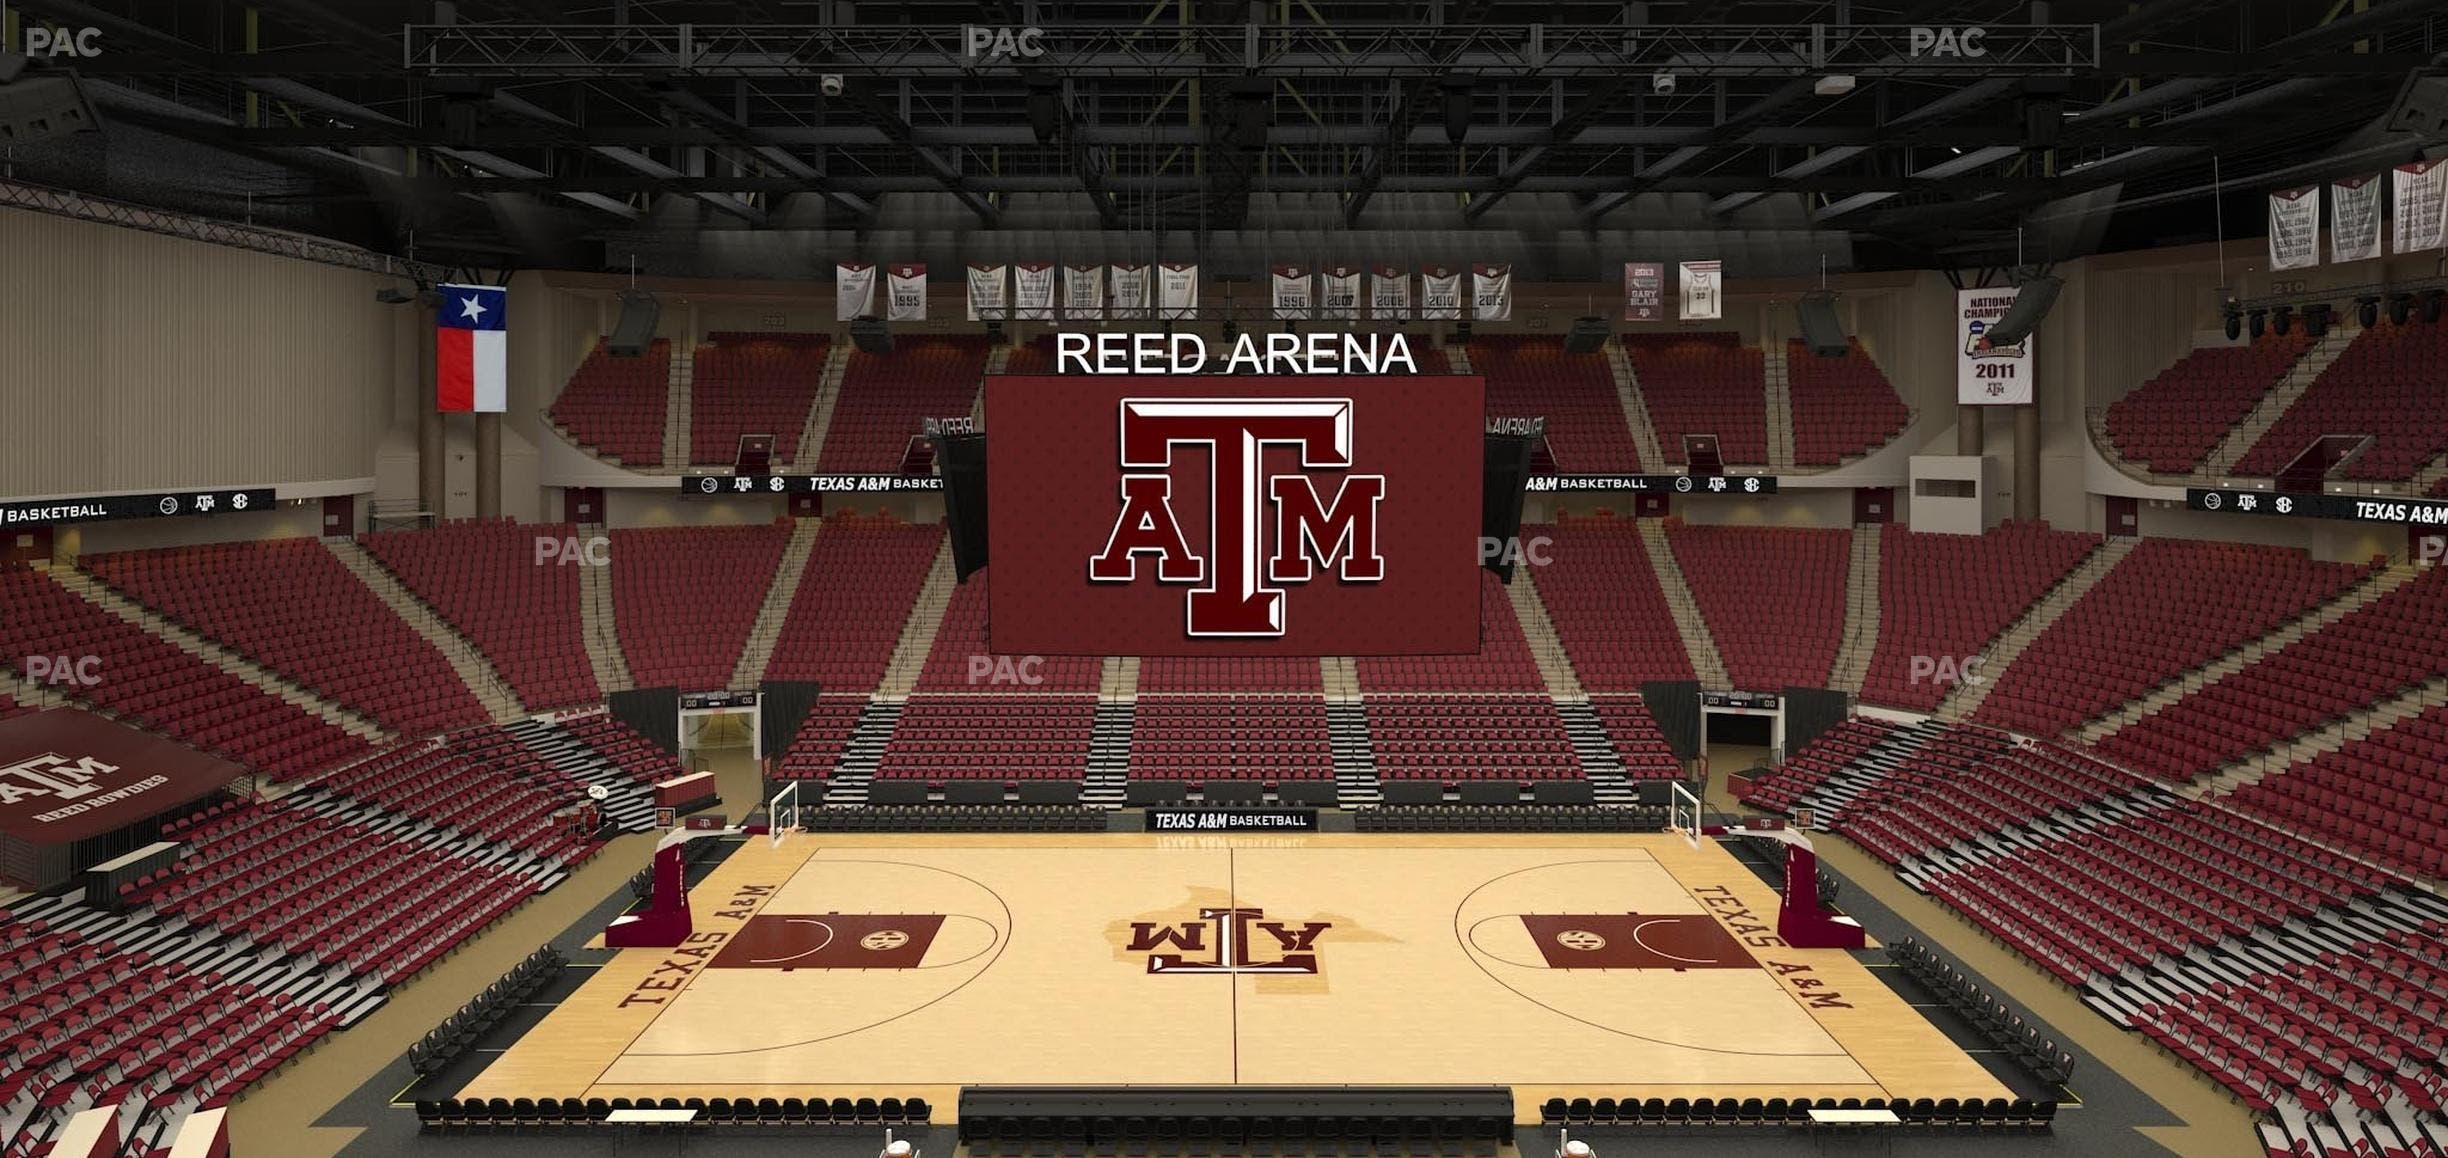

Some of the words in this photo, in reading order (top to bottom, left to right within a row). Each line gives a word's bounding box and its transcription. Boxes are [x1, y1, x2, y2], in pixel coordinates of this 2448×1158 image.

[894, 295, 921, 307] 1995
[1429, 295, 1454, 306] 2010
[1479, 295, 1503, 306] 2013
[1630, 298, 1658, 306] BLAIR
[1631, 290, 1657, 298] GARY
[1057, 332, 1206, 374] REED
[1225, 332, 1418, 374] ARENA
[1975, 363, 2015, 379] 2011
[810, 477, 855, 491] TEXAS
[857, 477, 891, 491] A&M
[1525, 477, 1558, 491] A&M
[1560, 478, 1647, 489] BASKETBALL
[7, 503, 107, 523] BASKETBALL
[2356, 501, 2406, 522] TEXAS
[2409, 503, 2448, 525] A&M
[32, 802, 91, 823] REED
[84, 774, 169, 808] ROWDIES
[1156, 813, 1196, 829] TEXAS
[1198, 813, 1228, 829] A&M
[1229, 815, 1307, 826] BASKETBALL
[617, 932, 729, 1008] TEXAS
[713, 885, 776, 920] A&M
[1693, 885, 1788, 947] TEXAS
[1767, 960, 1854, 1009] A&M
